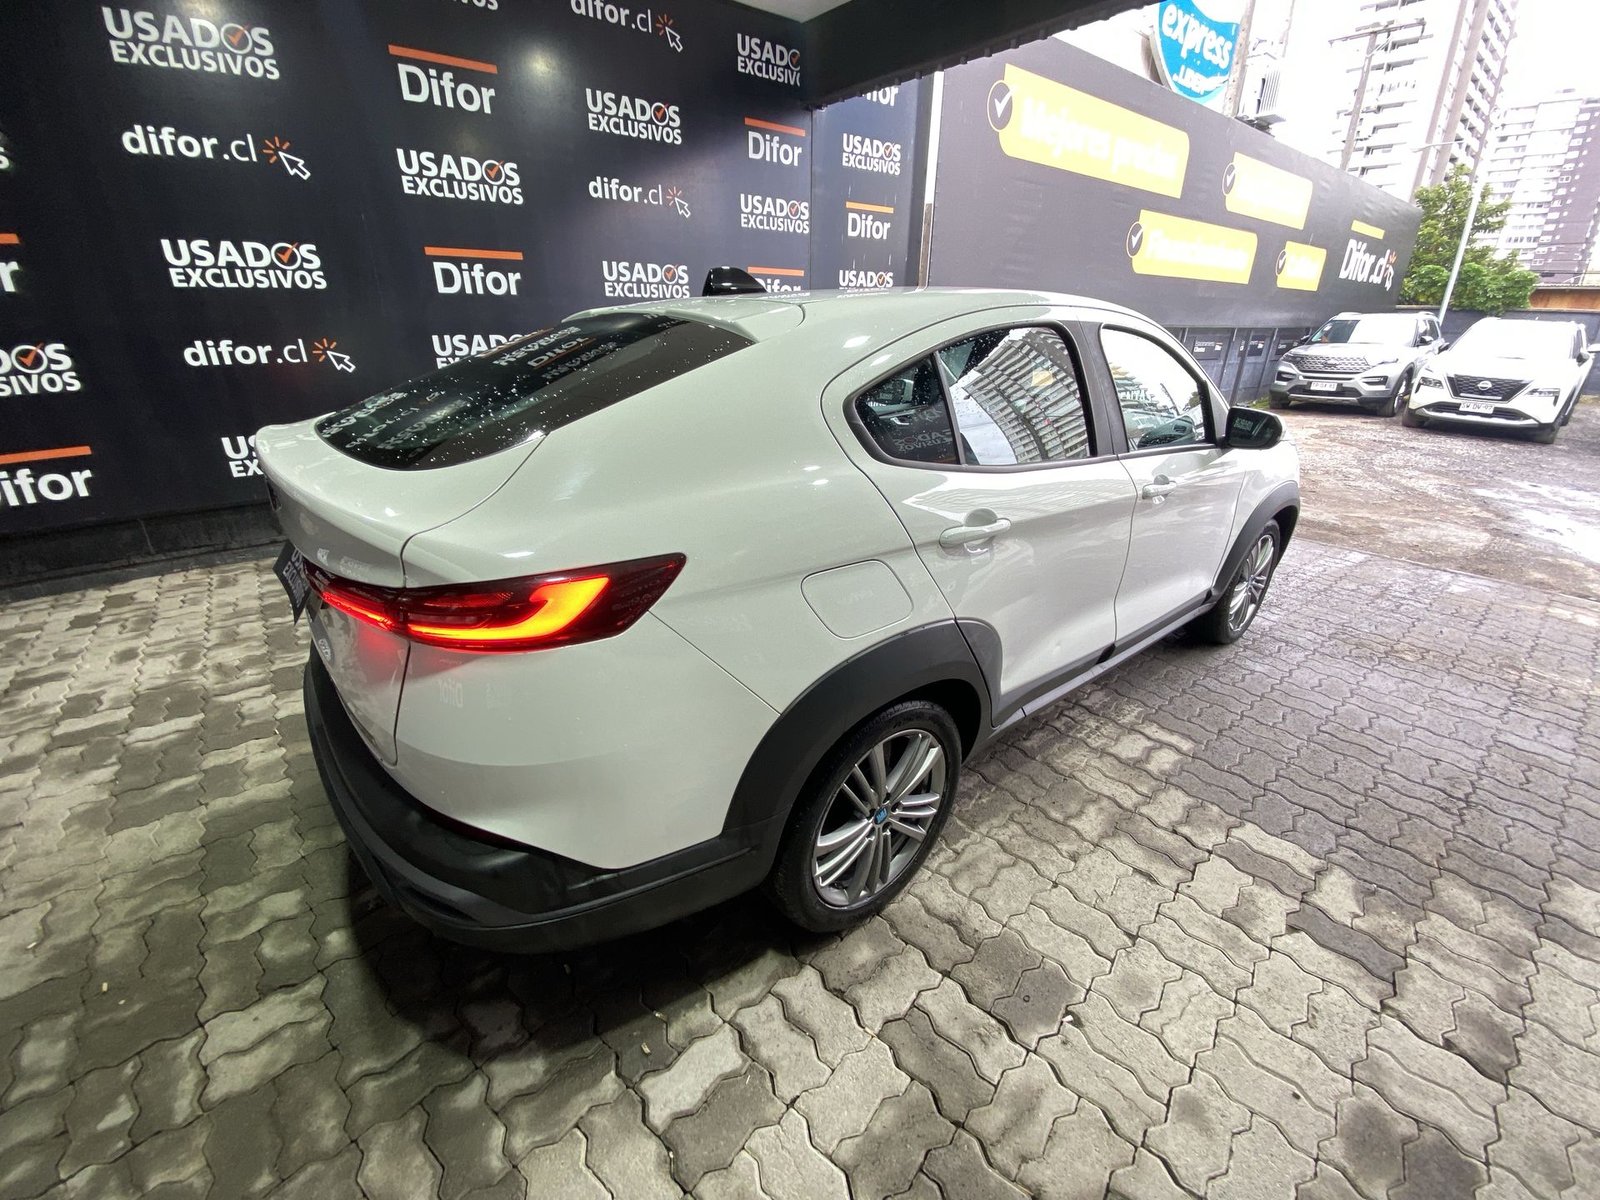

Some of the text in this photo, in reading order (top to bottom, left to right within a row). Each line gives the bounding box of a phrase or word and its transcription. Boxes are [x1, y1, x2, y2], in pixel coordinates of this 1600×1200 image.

[102, 7, 274, 57] USADOS
[1162, 4, 1232, 69] express
[110, 40, 280, 80] EXCLUSIVOS
[737, 33, 800, 71] USADO
[738, 55, 800, 87] EXCLUSIV
[398, 63, 496, 114] Difor
[586, 88, 680, 127] USADOS
[122, 125, 257, 162] difor.cl
[588, 113, 682, 145] EXCLUSIVOS
[749, 131, 802, 166] Difor
[842, 133, 901, 161] USADOS
[397, 148, 520, 186] USADOS
[842, 152, 901, 175] EXCLUSIVOS
[401, 175, 523, 205] EXCLUSIVOS
[588, 176, 663, 205] difor.cl
[740, 193, 809, 220] USADOS
[741, 214, 809, 234] EXCLUSIVOS
[848, 213, 890, 239] Difor
[161, 238, 321, 270] USADOS
[169, 267, 327, 290] EXCLUSIVOS
[433, 261, 521, 295] Difor
[602, 260, 689, 284] USADOS
[839, 270, 894, 287] USADOS
[605, 282, 690, 299] EXCLUSIVOS
[184, 339, 308, 366] difor.cl
[0, 468, 92, 507] ifor
